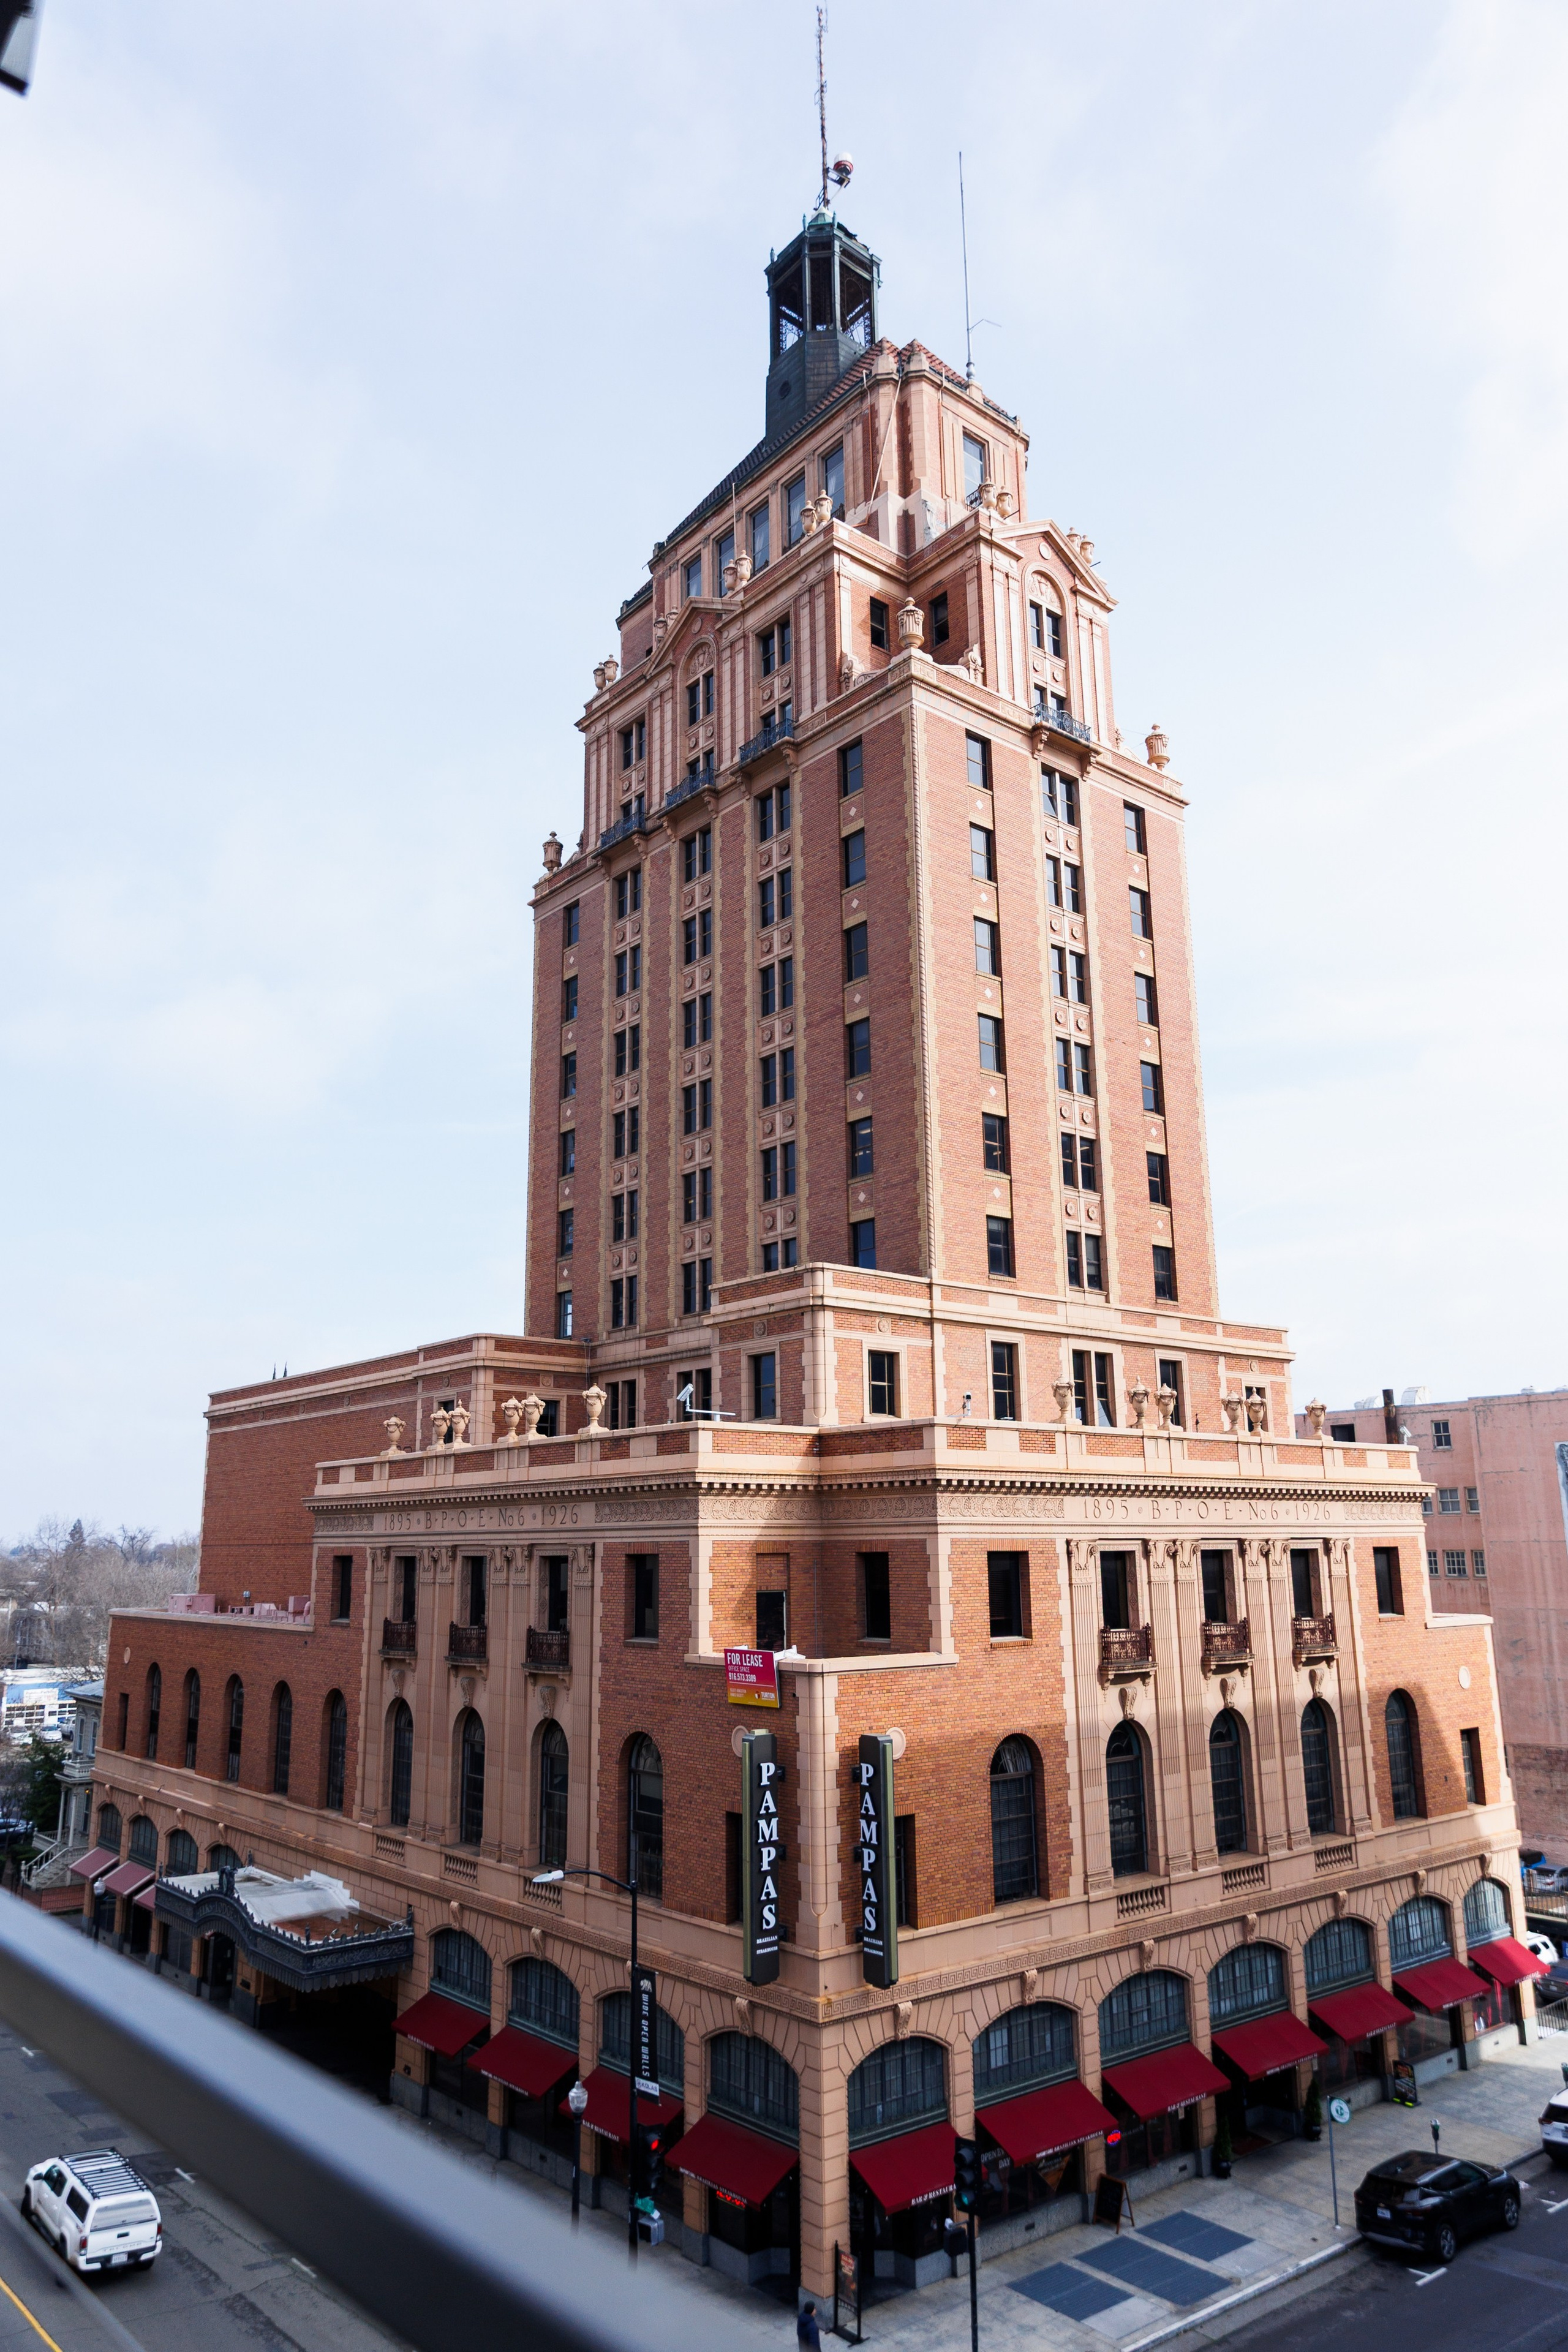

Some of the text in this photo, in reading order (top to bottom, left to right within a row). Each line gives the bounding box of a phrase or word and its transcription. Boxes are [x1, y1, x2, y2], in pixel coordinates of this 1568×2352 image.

[384, 1513, 411, 1531] 1895
[541, 1504, 578, 1525] 1926
[1084, 1498, 1128, 1520] 1895
[1295, 1502, 1330, 1520] 1926
[727, 1653, 763, 1667] FOR LEASE
[758, 1762, 779, 1930] PAMPAS
[859, 1763, 878, 1931] PAMPAS
[756, 1935, 778, 1944] BRAZILIAN
[864, 1936, 883, 1946] BRAZILIAN
[641, 2046, 650, 2077] WALLS
[981, 2149, 997, 2163] OPEN
[998, 2157, 1011, 2169] DAY
[911, 2196, 922, 2206] BAR
[929, 2184, 957, 2199] RESTAURA
